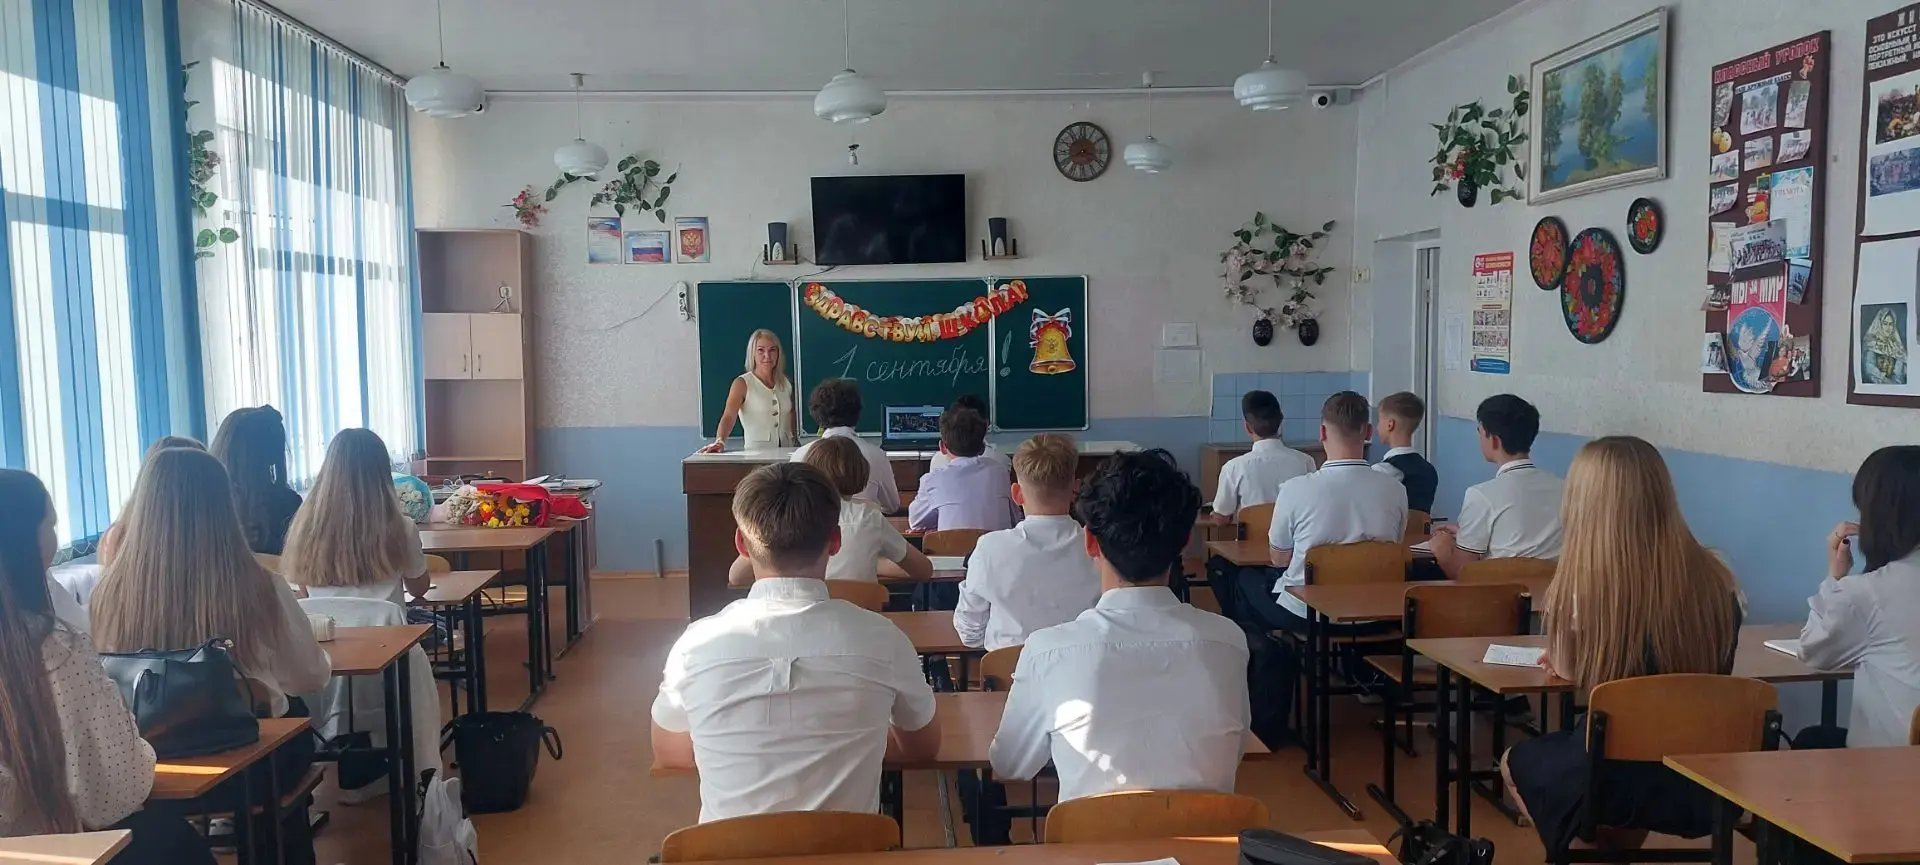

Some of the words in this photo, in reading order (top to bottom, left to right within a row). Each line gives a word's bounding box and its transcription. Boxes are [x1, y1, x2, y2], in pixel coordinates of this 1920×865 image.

[1714, 52, 1770, 84] КЛАССНЫЙ
[1775, 37, 1820, 65] УГОЛОК
[1872, 33, 1885, 44] ЭТО
[1731, 281, 1748, 304] МЫ
[1759, 275, 1784, 303] МИР
[804, 285, 933, 343] ЗДРАВСТВУЙ
[833, 344, 857, 380] 1
[866, 343, 988, 387] сентября
